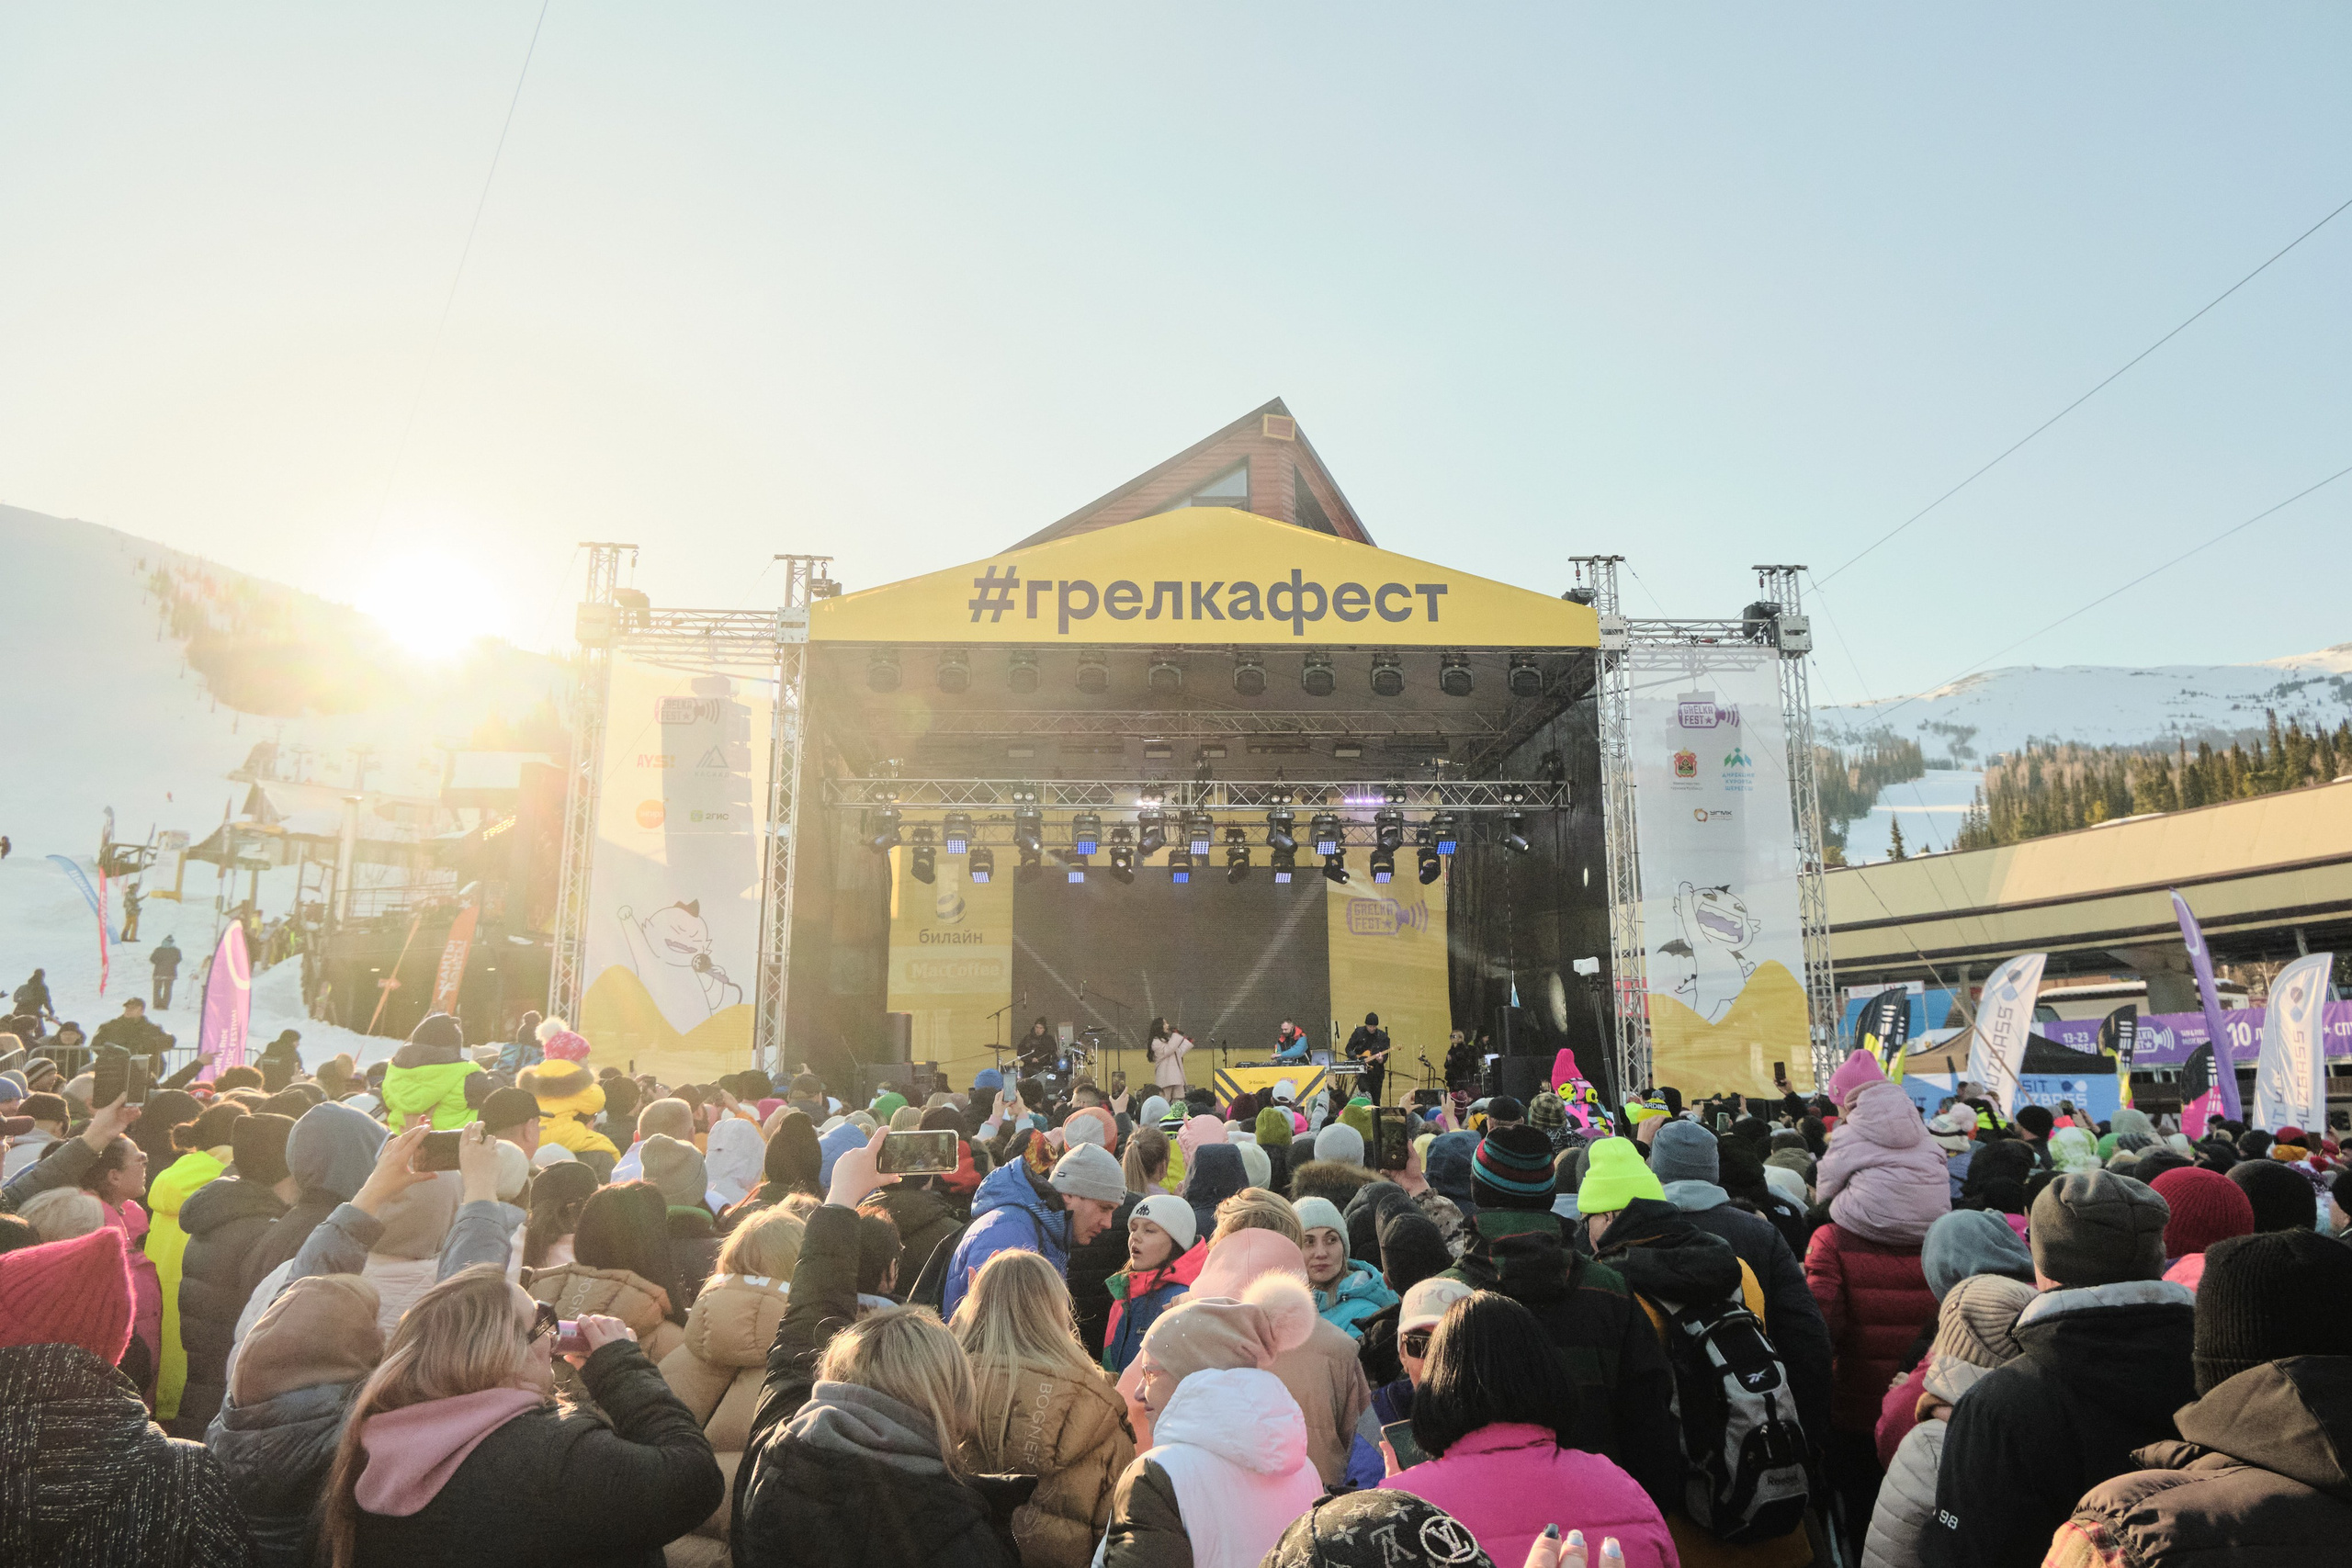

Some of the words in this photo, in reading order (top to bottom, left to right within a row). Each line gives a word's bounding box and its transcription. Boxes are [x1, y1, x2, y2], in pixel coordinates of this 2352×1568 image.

[968, 565, 1449, 637] #грелкафест
[661, 710, 682, 721] FEST
[1683, 705, 1713, 715] GRELKA
[1684, 715, 1705, 725] FEST
[706, 812, 729, 821] 2ГИС
[1354, 903, 1394, 916] GRELKA
[1354, 917, 1381, 930] FEST
[919, 928, 983, 944] билайн
[2063, 1032, 2089, 1043] 13-23
[2226, 1021, 2252, 1047] 10
[1984, 1006, 2013, 1093] UZBASS
[564, 1277, 600, 1319] BOGN
[1023, 1382, 1053, 1465] BOGNER
[1767, 1472, 1801, 1486] Reebok
[1939, 1509, 1959, 1530] 98
